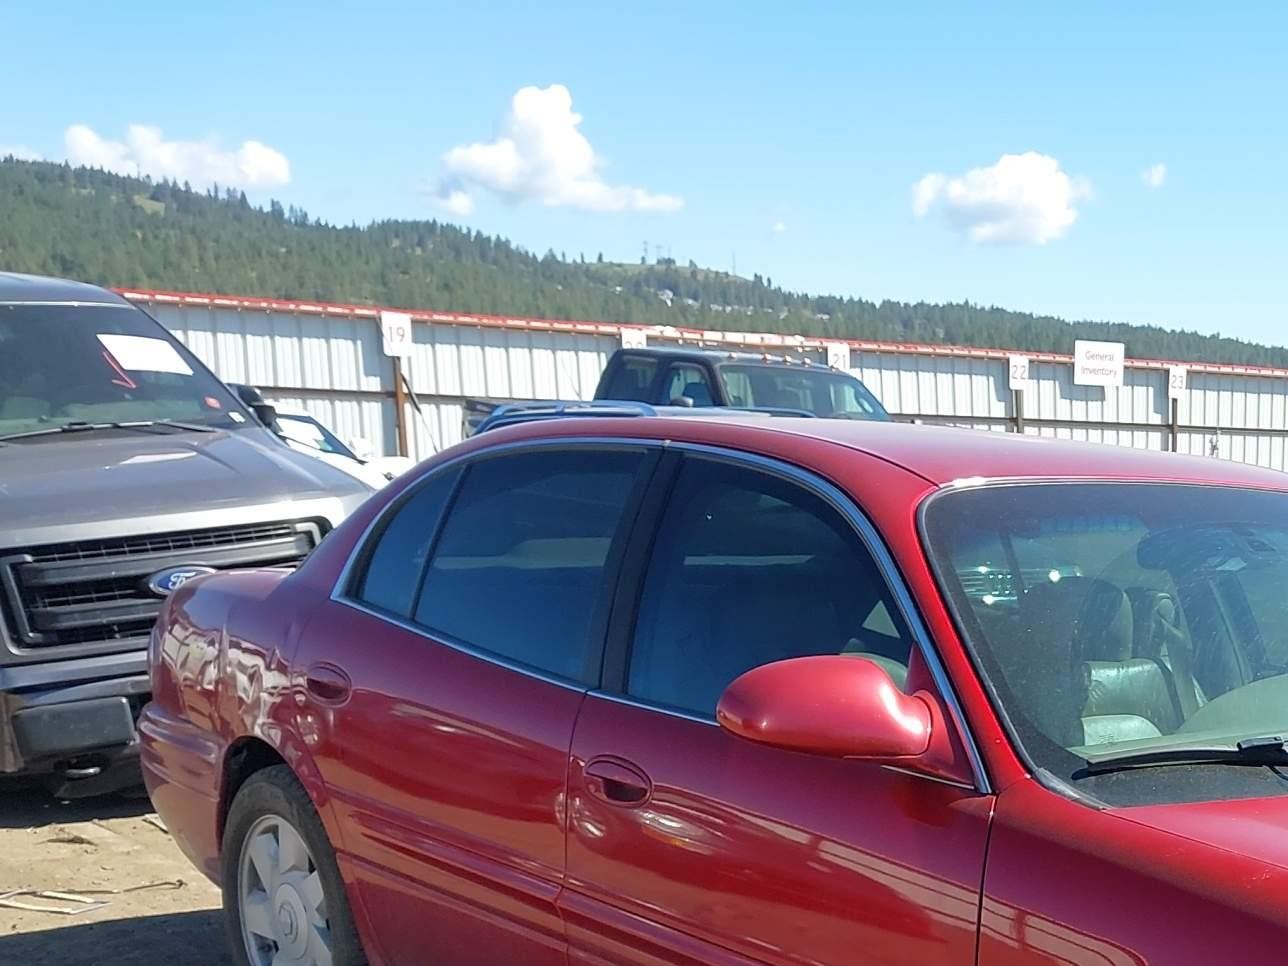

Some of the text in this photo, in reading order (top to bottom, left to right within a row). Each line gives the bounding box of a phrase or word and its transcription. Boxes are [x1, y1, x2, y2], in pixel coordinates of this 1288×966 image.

[389, 326, 405, 342] 19
[832, 352, 847, 369] 21
[1084, 350, 1115, 361] General
[1011, 365, 1027, 380] 22
[1080, 366, 1118, 378] Inventory
[1171, 374, 1184, 389] 23
